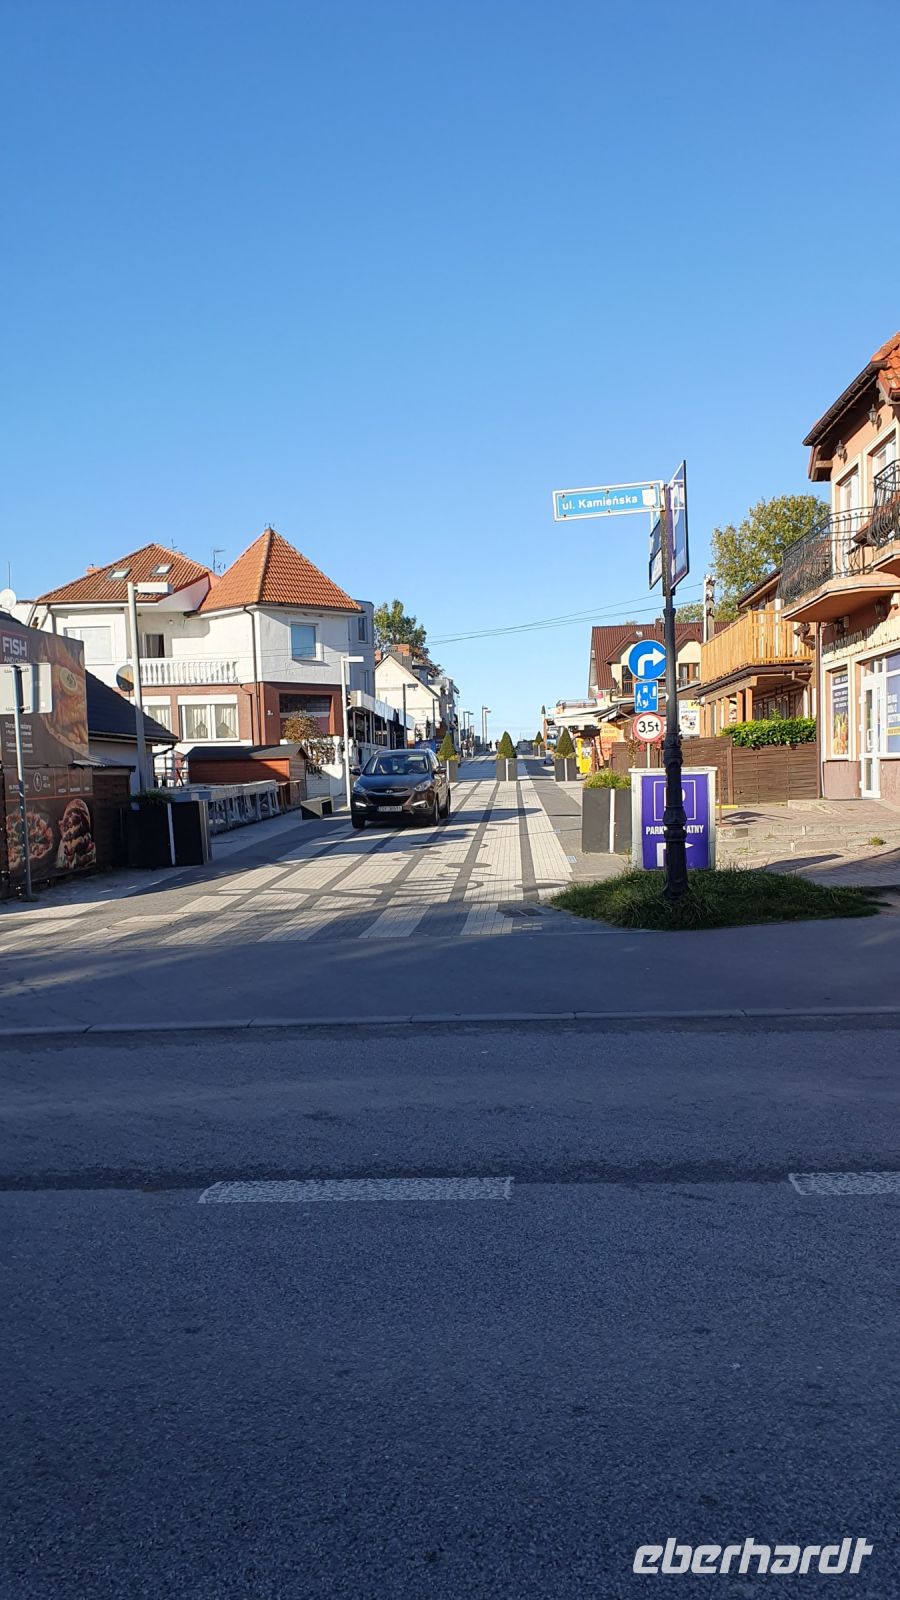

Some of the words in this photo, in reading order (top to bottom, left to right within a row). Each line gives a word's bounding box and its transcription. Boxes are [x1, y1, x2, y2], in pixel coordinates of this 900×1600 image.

[562, 501, 575, 511] ul.
[578, 495, 638, 509] Kamieńska
[2, 636, 27, 657] FISH
[645, 825, 668, 835] PARK
[682, 824, 704, 834] ATNY
